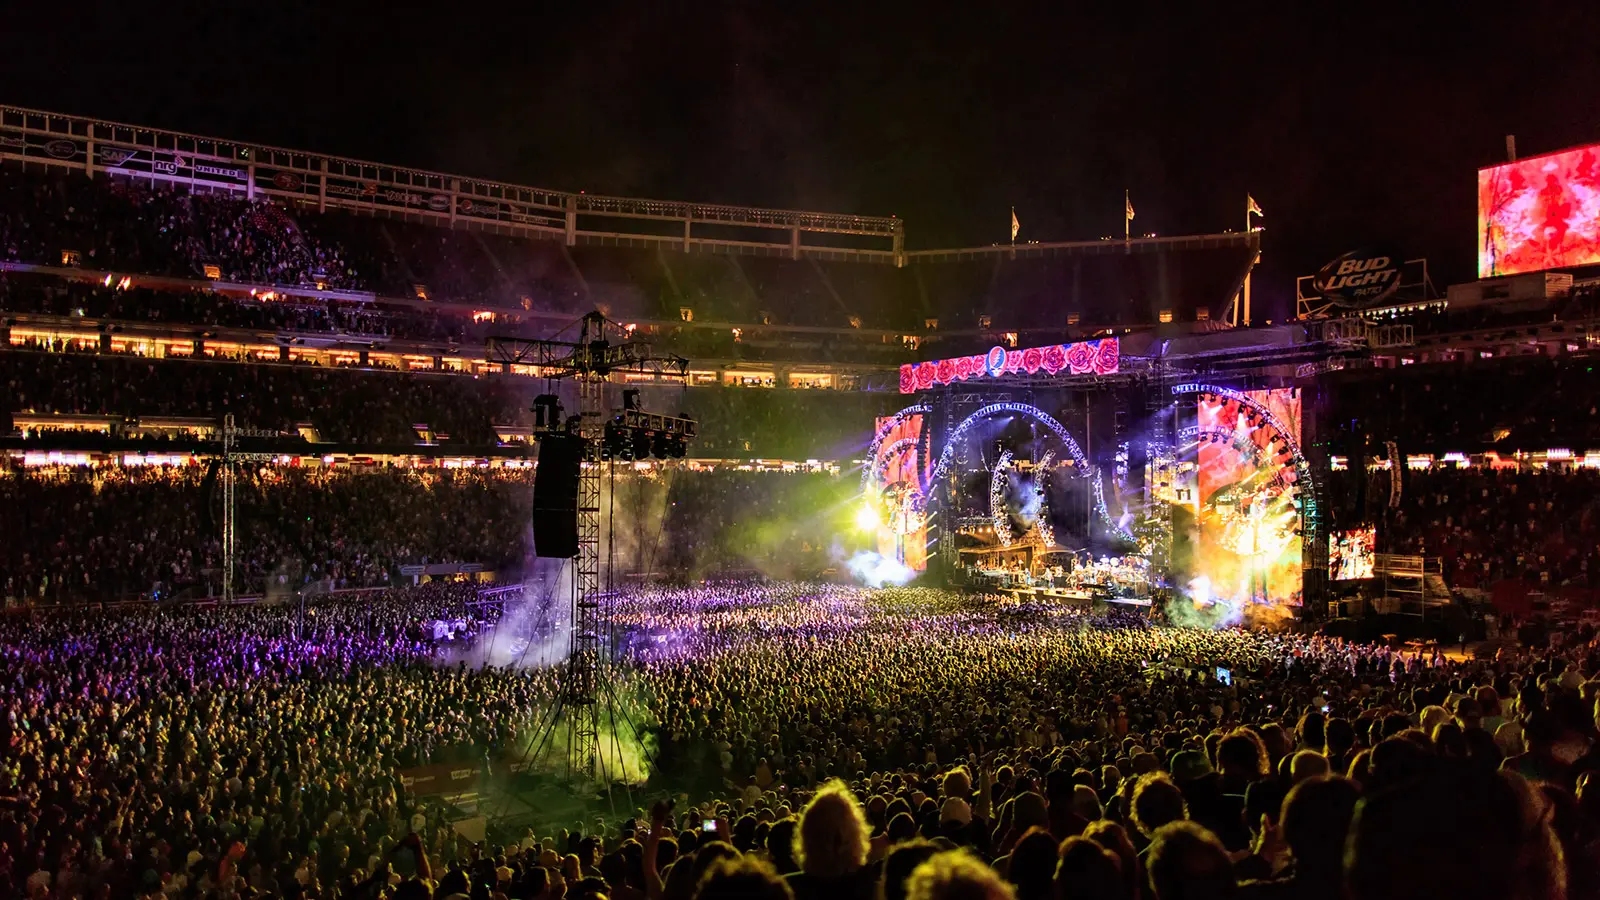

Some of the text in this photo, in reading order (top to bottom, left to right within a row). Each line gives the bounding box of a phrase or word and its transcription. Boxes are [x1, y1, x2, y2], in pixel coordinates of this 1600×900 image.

[103, 149, 126, 162] SAP
[155, 160, 177, 175] nrg
[196, 164, 236, 177] UNITED
[1337, 256, 1391, 275] BUD
[1324, 268, 1397, 290] LIGHT
